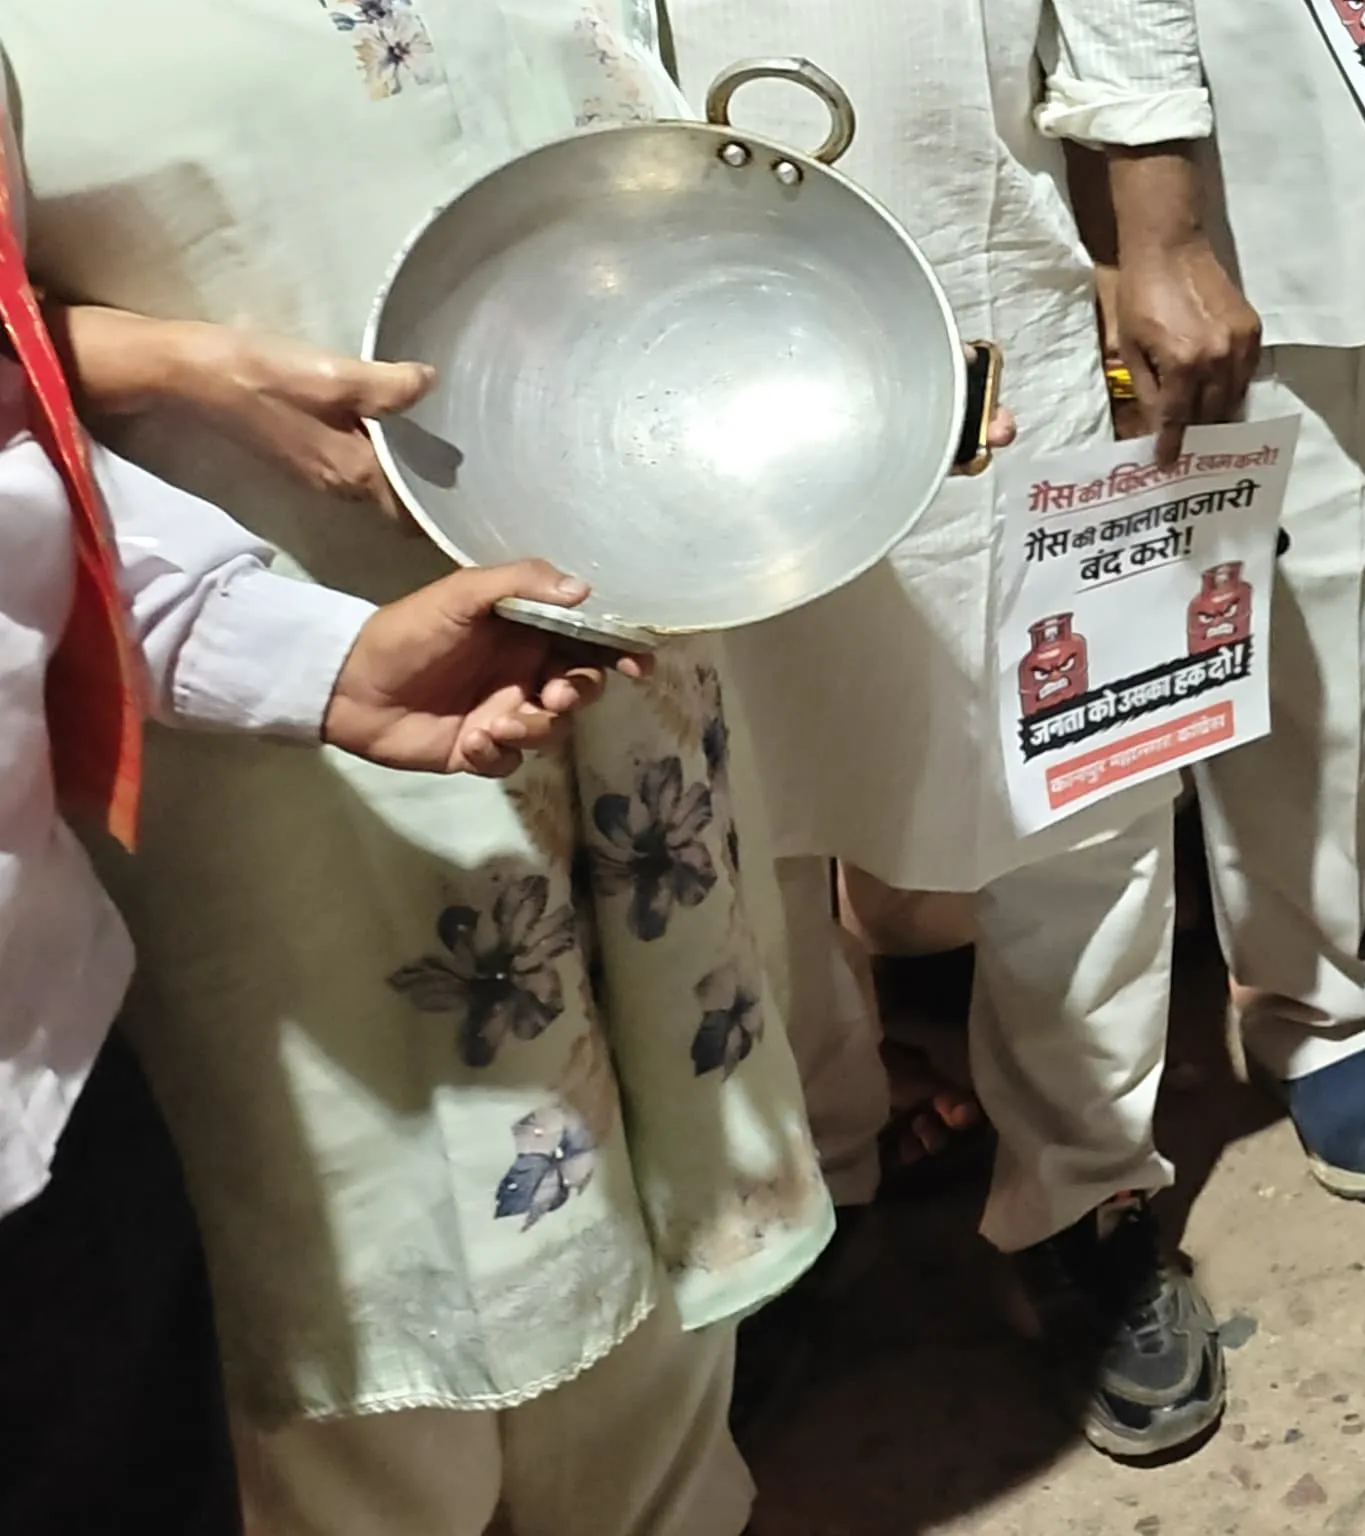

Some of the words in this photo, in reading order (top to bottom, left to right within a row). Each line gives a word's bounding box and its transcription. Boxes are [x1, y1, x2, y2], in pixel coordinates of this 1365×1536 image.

[1025, 527, 1070, 563] गैस
[1071, 526, 1097, 549] की
[1100, 478, 1261, 542] कालाबाजारी
[1028, 481, 1077, 513] गैस
[1077, 479, 1107, 505] की
[1080, 547, 1124, 583] बंद
[1129, 525, 1194, 566] करो!
[1029, 708, 1085, 747] जनता
[1087, 690, 1118, 723] को
[1117, 676, 1169, 712] उसका
[1171, 667, 1206, 695] हक
